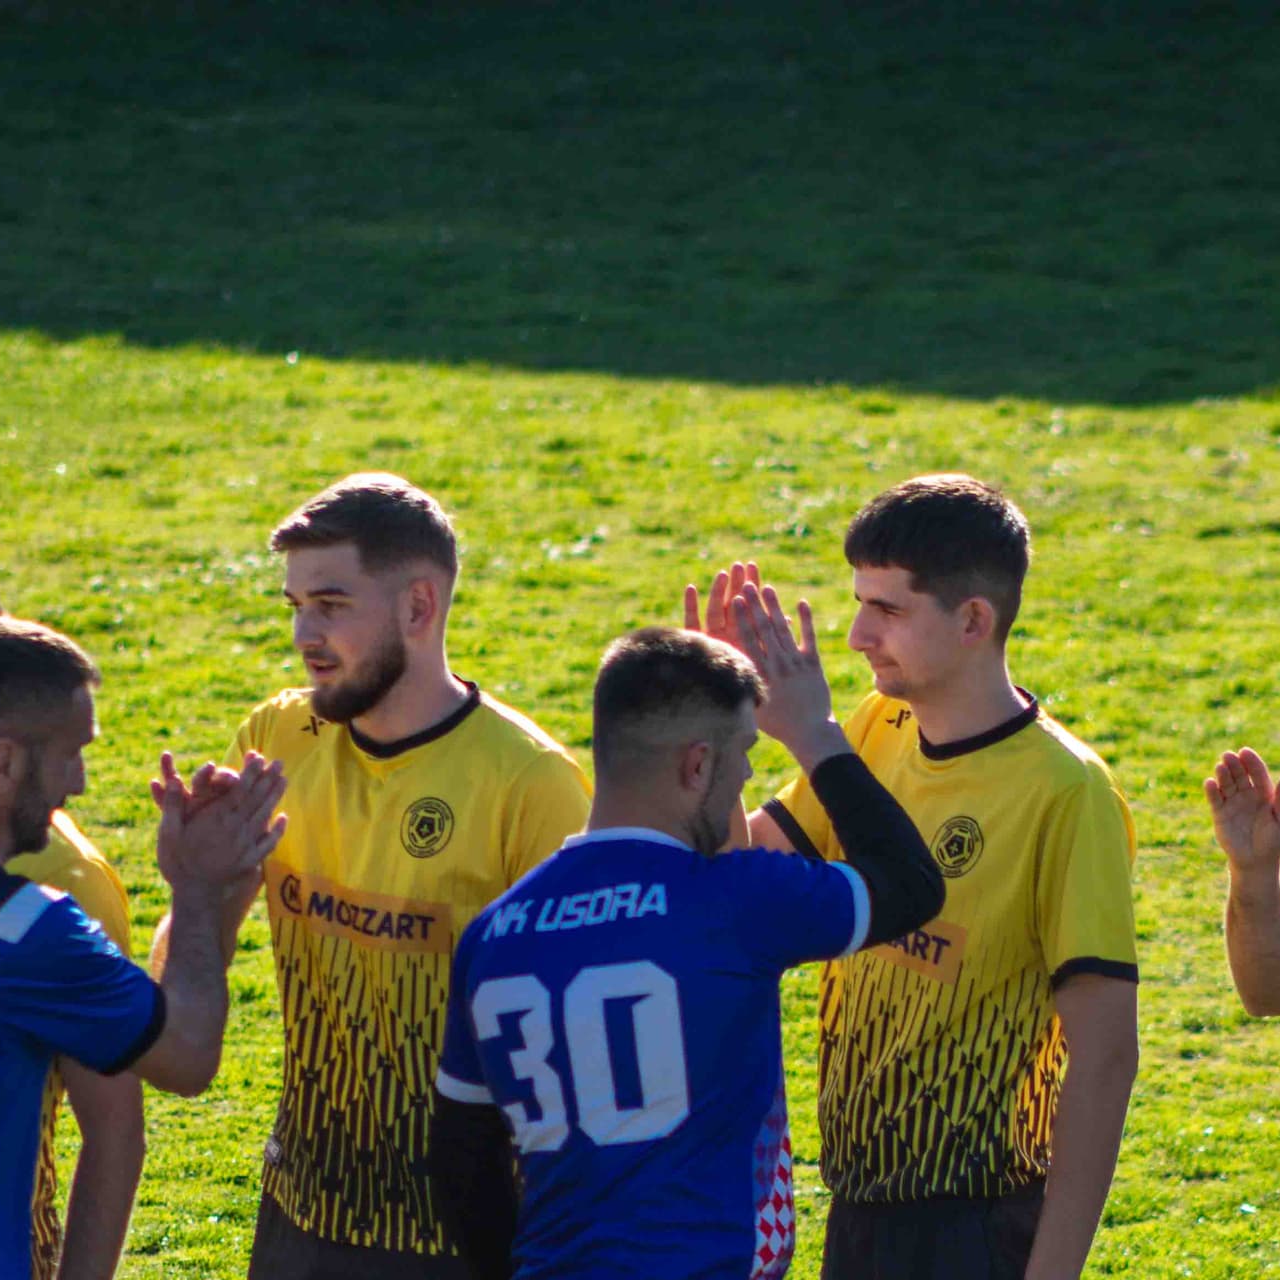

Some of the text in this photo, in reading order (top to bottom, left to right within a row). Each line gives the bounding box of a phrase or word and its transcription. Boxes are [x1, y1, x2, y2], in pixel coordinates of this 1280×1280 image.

[307, 891, 436, 941] MOZZART
[481, 883, 668, 942] NK USORA
[471, 959, 690, 1155] 30
